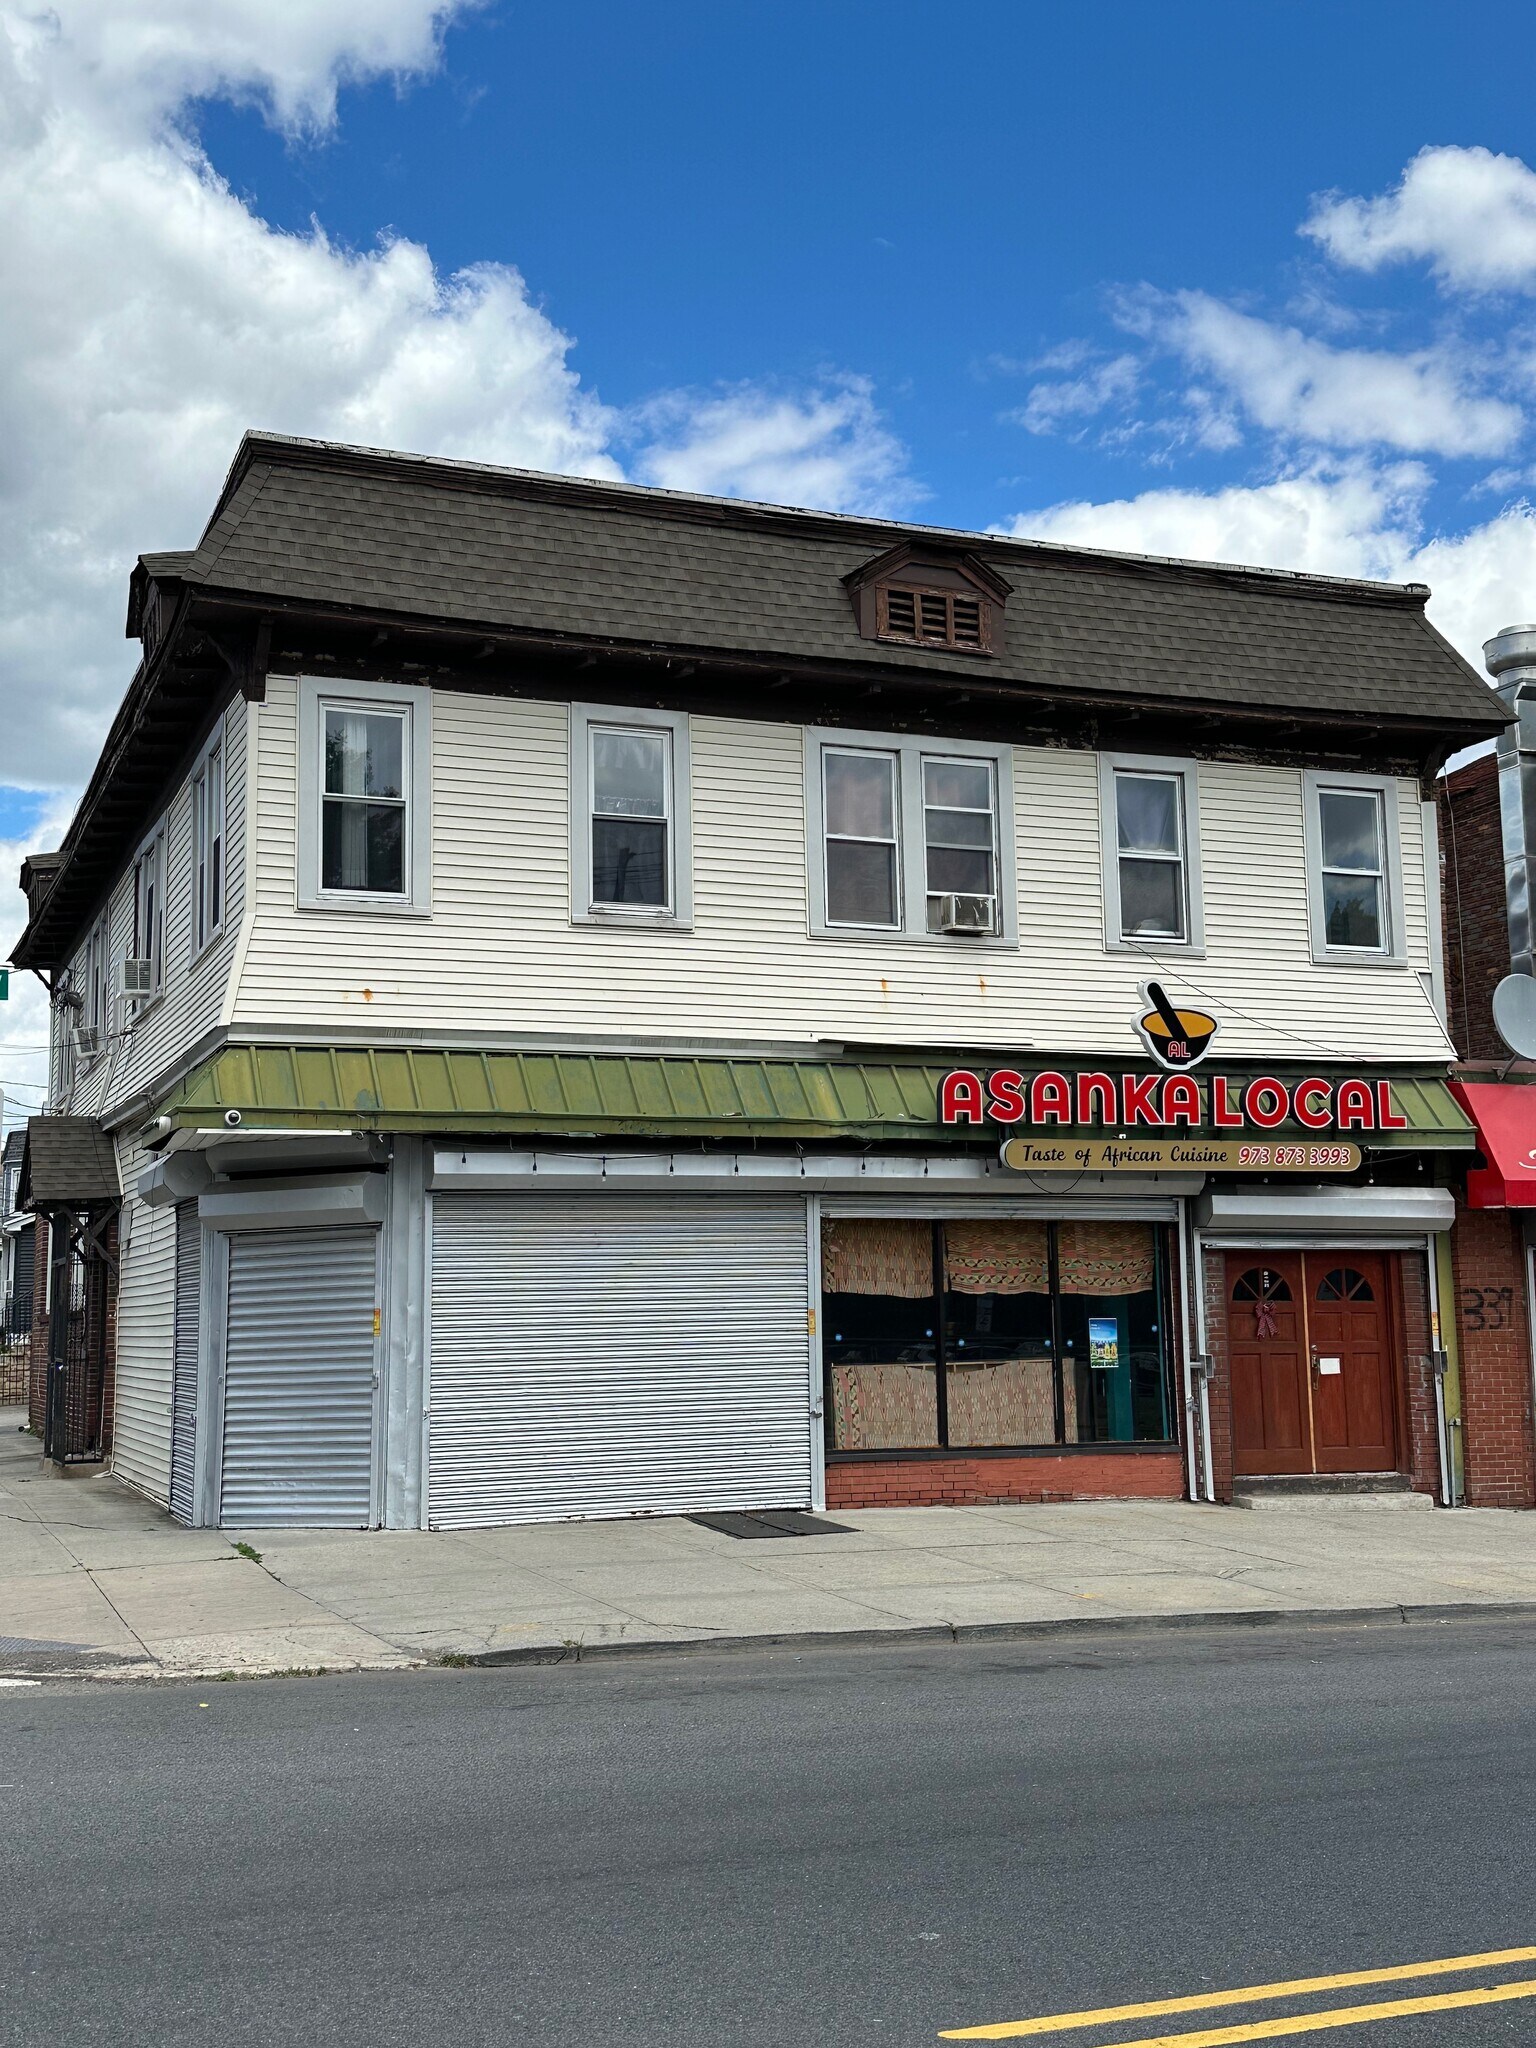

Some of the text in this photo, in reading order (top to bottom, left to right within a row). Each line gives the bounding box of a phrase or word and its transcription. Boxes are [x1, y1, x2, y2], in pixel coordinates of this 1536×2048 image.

[1167, 1041, 1191, 1058] AL
[942, 1069, 1408, 1131] ASANKA LOCAL
[1022, 1145, 1351, 1167] Taste of African Cuisine 973 873 3993
